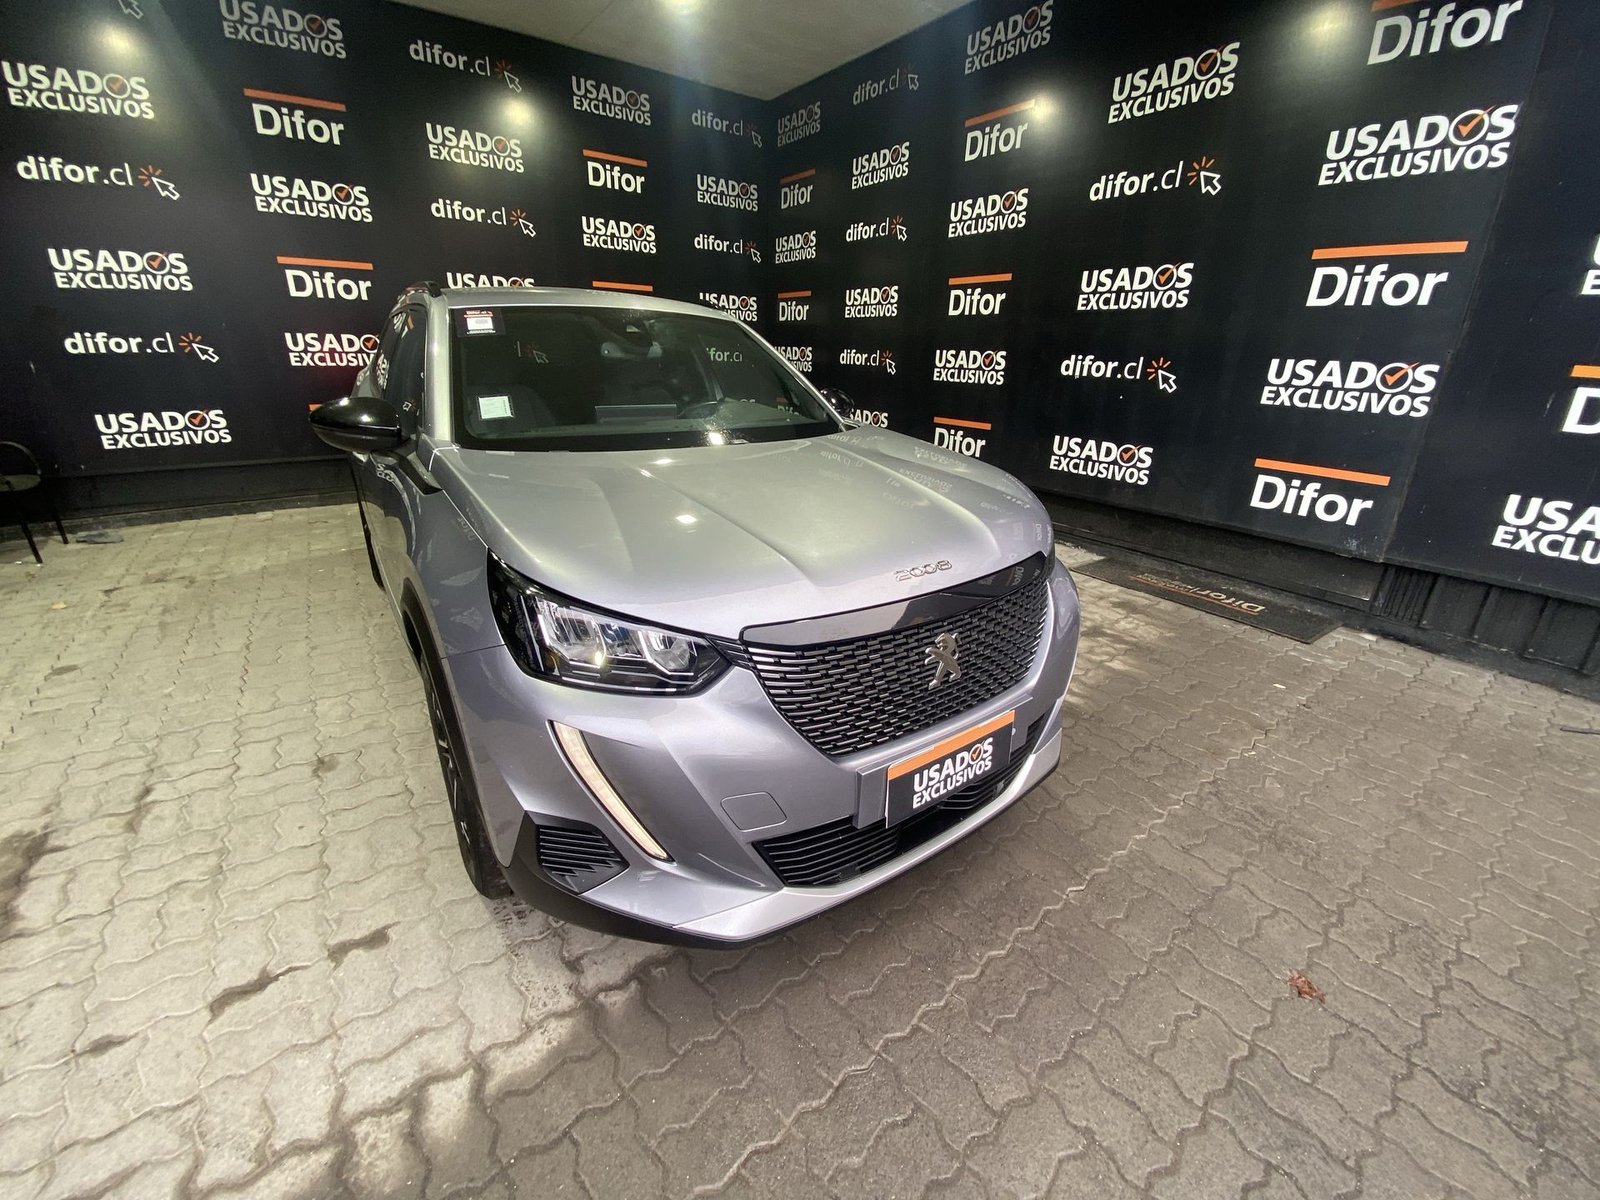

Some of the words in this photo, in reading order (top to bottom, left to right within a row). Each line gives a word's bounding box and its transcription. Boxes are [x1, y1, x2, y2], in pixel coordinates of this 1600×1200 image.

[220, 0, 344, 41] USADOS
[966, 0, 1053, 53] USADOS
[1367, 0, 1523, 66] Difor
[223, 23, 347, 59] EXCLUSIVOS
[965, 25, 1052, 75] EXCLUSIVOS
[409, 39, 492, 77] difor.cl
[1111, 41, 1241, 102] USADOS
[1, 60, 151, 101] USADOS
[571, 75, 650, 112] USADOS
[852, 68, 900, 105] difor.cl
[7, 87, 155, 120] EXCLUSIVOS
[573, 96, 651, 126] EXCLUSIVOS
[1107, 73, 1236, 124] EXCLUSIVOS
[251, 102, 346, 146] Difor
[692, 109, 744, 137] difor.cl
[778, 101, 821, 134] USADOS
[1325, 103, 1519, 161] USADOS
[426, 122, 522, 158] USADOS
[777, 119, 821, 147] EXCLUSIVOS
[964, 122, 1028, 162] Difor
[16, 155, 135, 188] difor.cl
[429, 143, 525, 173] EXCLUSIVOS
[852, 141, 910, 176] USADOS
[1317, 141, 1511, 186] EXCLUSIVOS
[250, 173, 369, 208] USADOS
[587, 160, 646, 195] Difor
[697, 174, 758, 199] USADOS
[851, 164, 909, 190] EXCLUSIVOS
[1089, 161, 1184, 201] difor.cl
[255, 196, 373, 223] EXCLUSIVOS
[697, 191, 759, 211] EXCLUSIVOS
[781, 184, 814, 210] Difor
[950, 187, 1029, 223] USADOS
[430, 198, 507, 227] difor.cl
[948, 210, 1026, 239] EXCLUSIVOS
[582, 215, 656, 241] USADOS
[776, 230, 817, 252] USADOS
[846, 217, 889, 242] difor.cl
[583, 233, 657, 254] EXCLUSIVOS
[694, 234, 743, 255] difor.cl
[775, 247, 816, 264] EXCLUSIVOS
[47, 248, 189, 275] USADOS
[54, 271, 193, 292] EXCLUSIVOS
[285, 268, 372, 301] Difor
[1080, 262, 1195, 293] USADOS
[1305, 263, 1449, 307] Difor
[844, 300, 898, 319] EXCLUSIVOS
[845, 285, 899, 306] USADOS
[948, 287, 1006, 316] Difor
[1077, 289, 1190, 311] EXCLUSIVOS
[779, 301, 810, 322] Difor
[63, 331, 175, 354] difor.cl
[284, 332, 380, 353] USADO
[289, 352, 375, 367] EXCLUSIV
[839, 349, 880, 367] difor.cl
[935, 350, 1007, 371] USADOS
[1060, 355, 1144, 379] difor.cl
[933, 367, 1005, 387] EXCLUSIVOS
[1266, 358, 1441, 394] USADOS
[1259, 386, 1432, 418] EXCLUSIVOS
[94, 409, 228, 436] USADOS
[100, 429, 232, 450] EXCLUSIVOS
[934, 428, 986, 458] Difor
[1053, 435, 1154, 468] USADOS
[1050, 455, 1150, 486] EXCLUSIVOS
[1250, 473, 1373, 527] Difor
[895, 560, 952, 582] 2008
[913, 737, 993, 792] USADOS
[912, 756, 992, 809] EXCLUSIVOS
